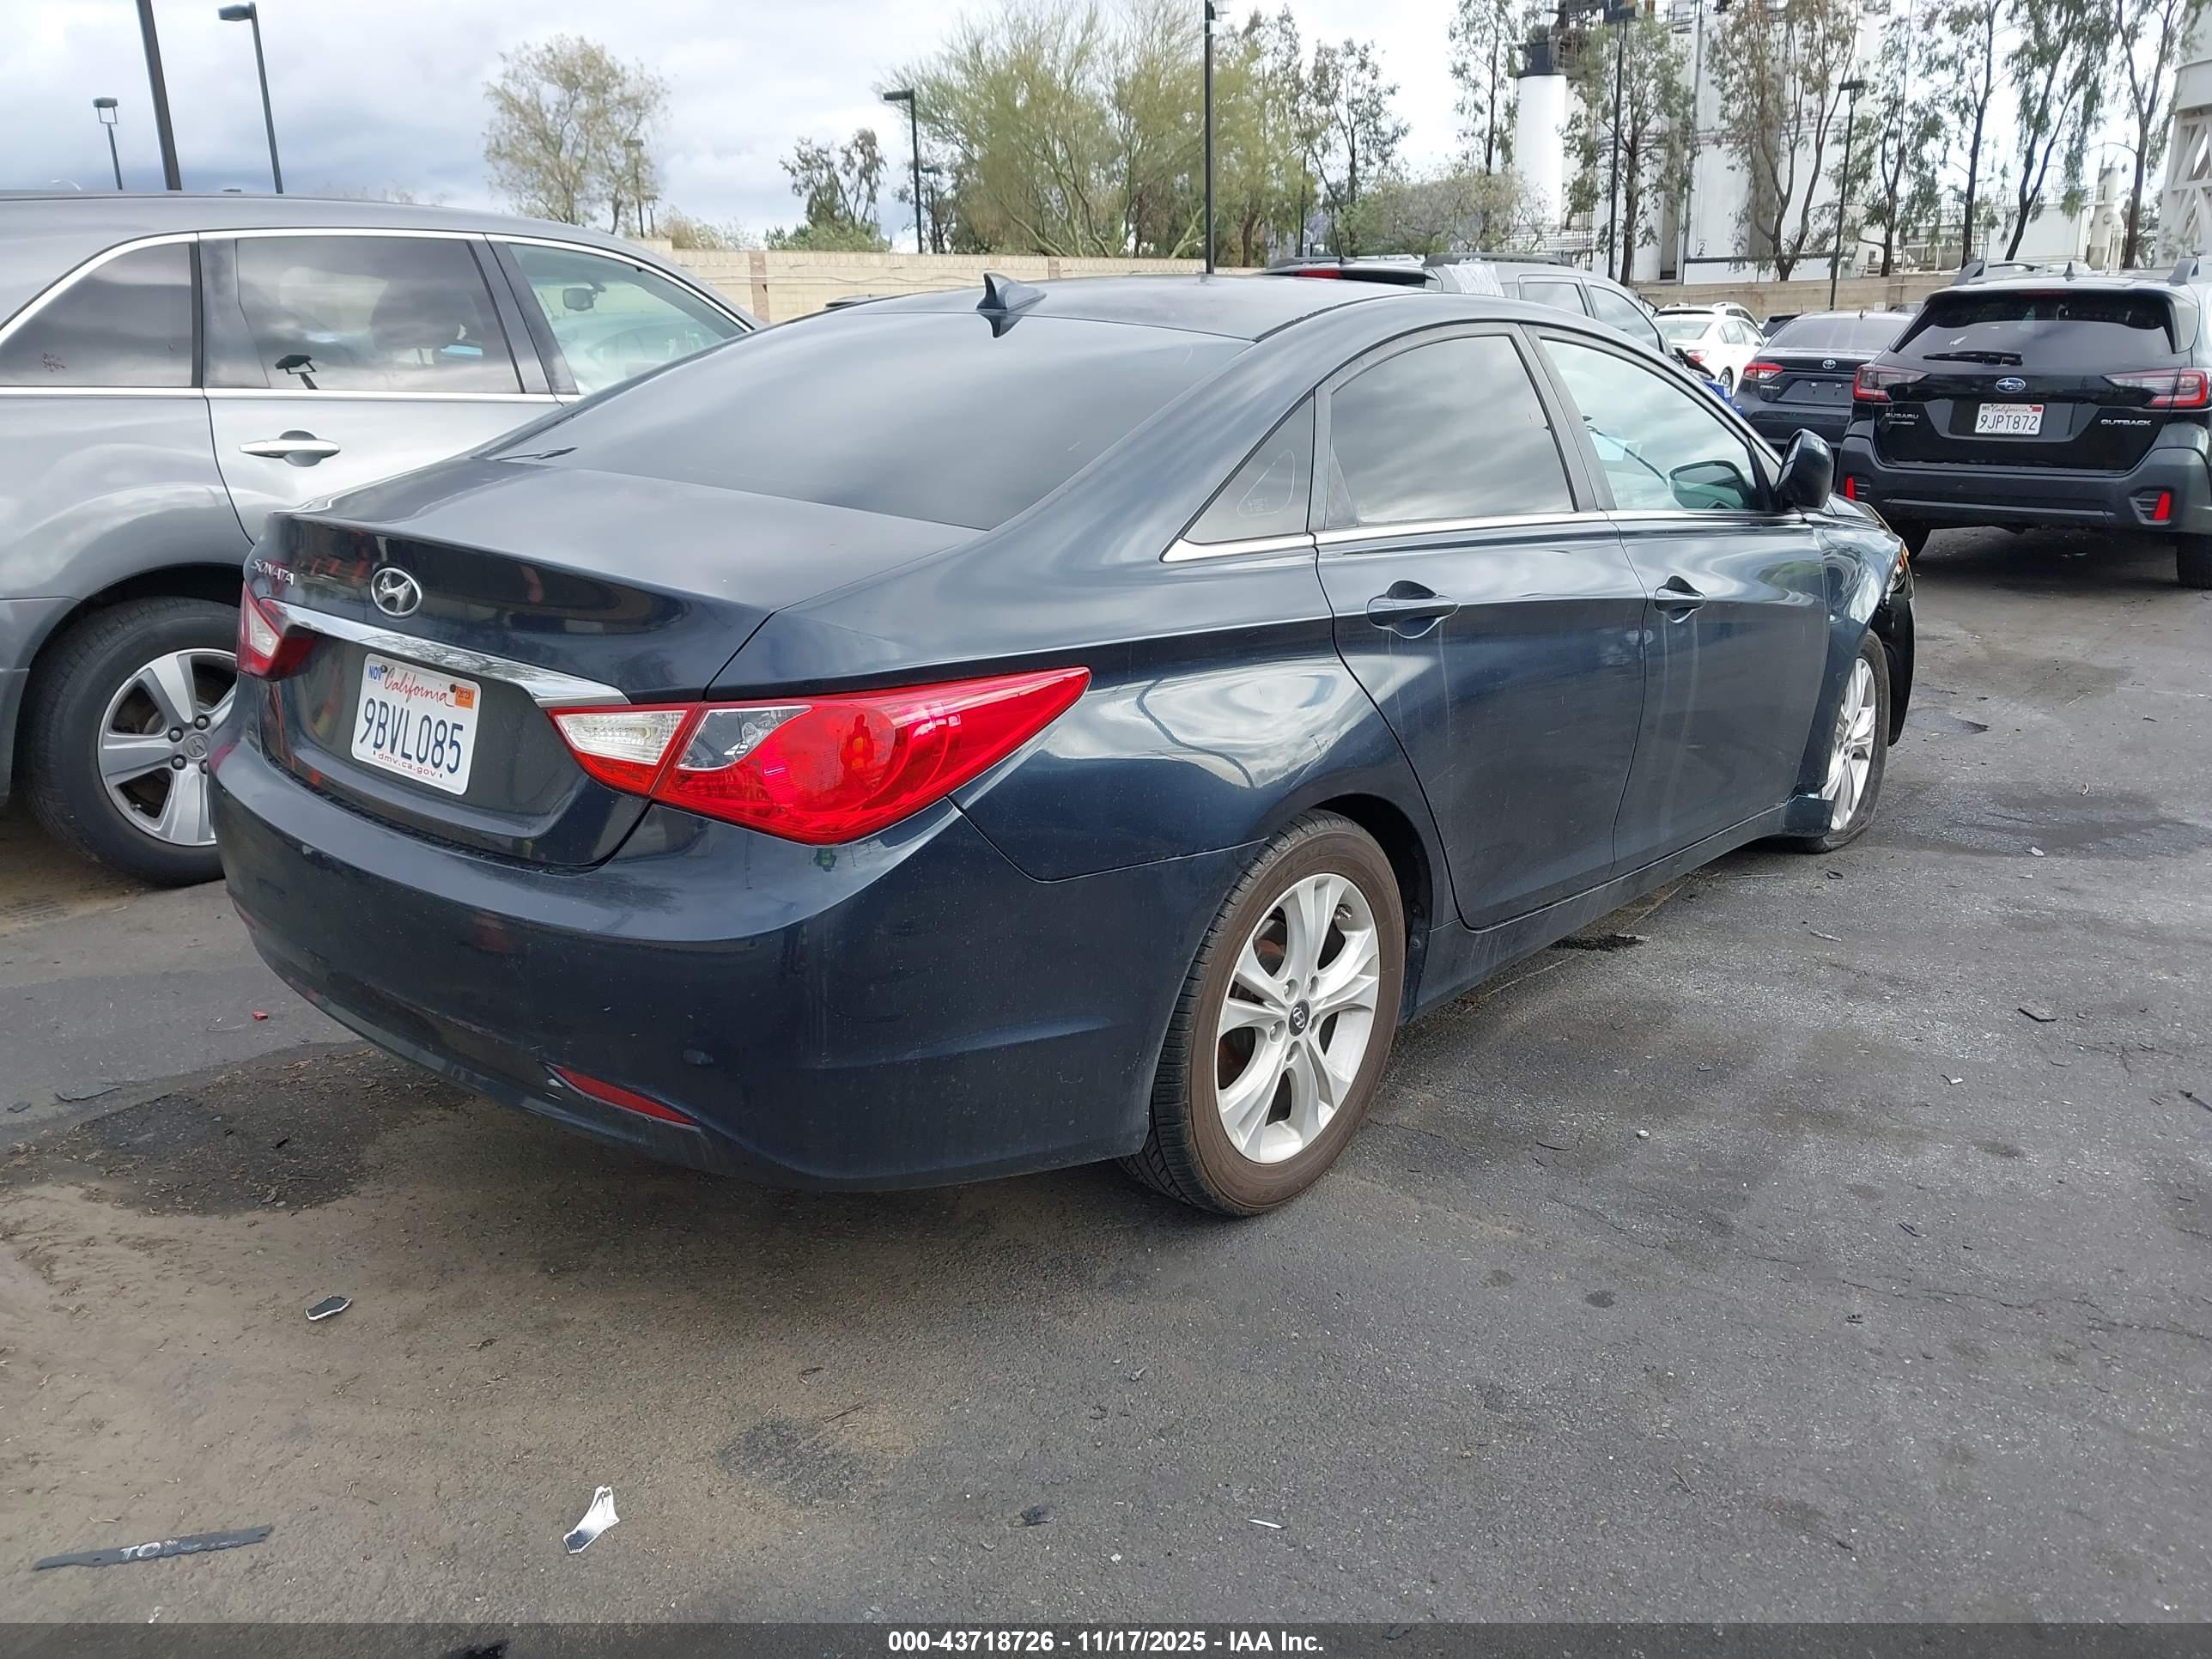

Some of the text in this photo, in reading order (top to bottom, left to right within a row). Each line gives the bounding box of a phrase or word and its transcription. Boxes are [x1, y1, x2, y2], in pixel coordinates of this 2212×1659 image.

[1991, 404, 2032, 415] California
[1978, 415, 2039, 431] 9JPT872
[250, 558, 295, 586] SONATA
[368, 665, 384, 682] NOV
[384, 666, 455, 708] California
[359, 697, 465, 775] 9BVL085
[378, 752, 437, 778] dmv.ca.gov
